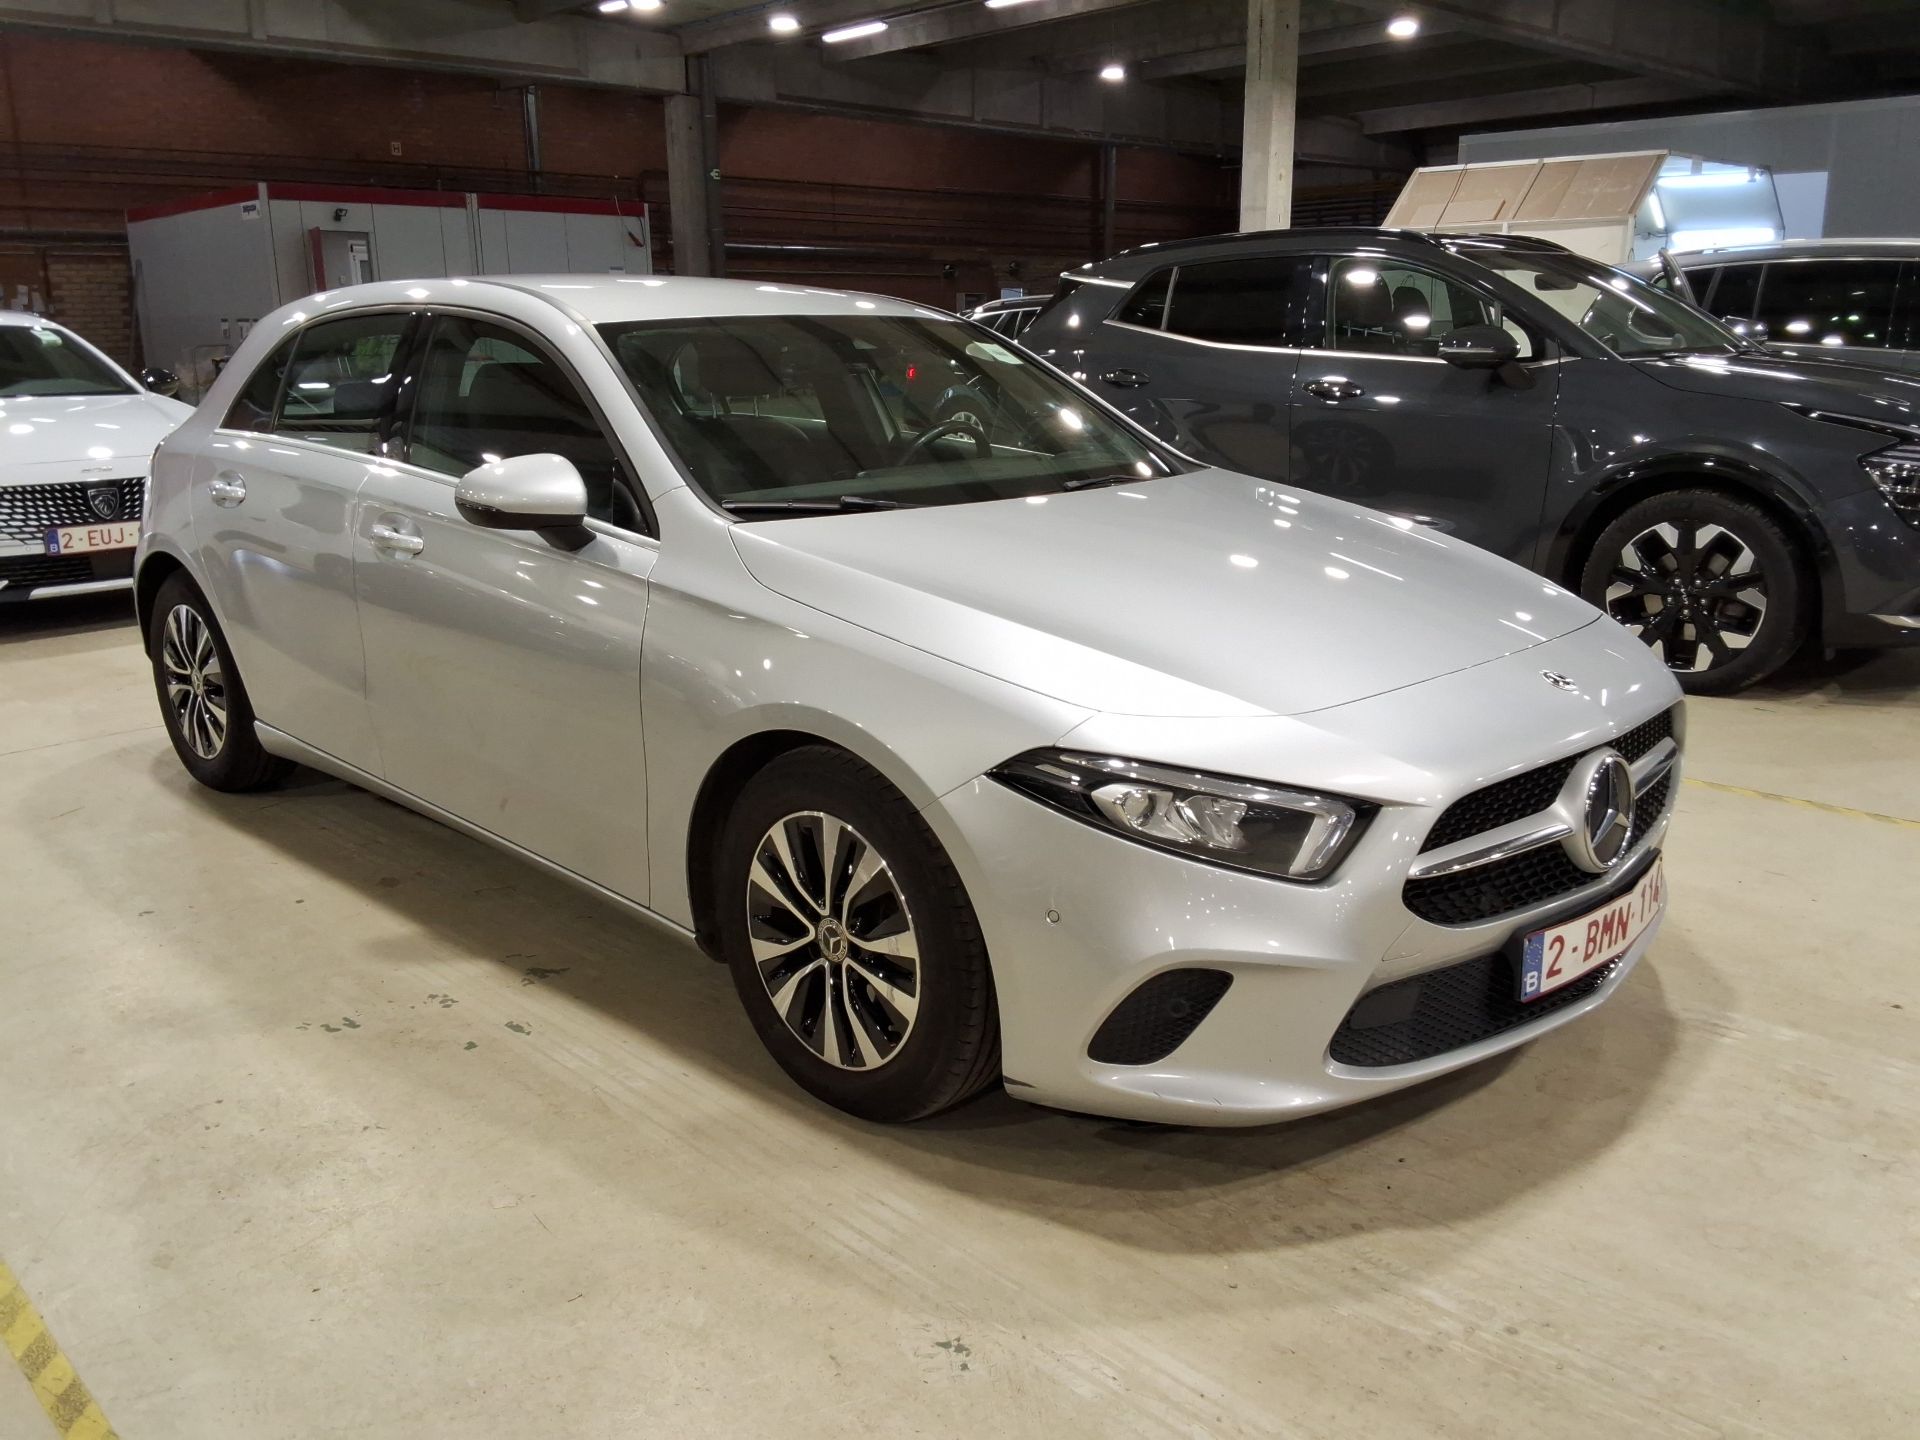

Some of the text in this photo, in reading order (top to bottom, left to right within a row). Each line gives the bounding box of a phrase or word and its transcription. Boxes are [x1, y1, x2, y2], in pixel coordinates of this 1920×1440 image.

[50, 544, 58, 553] B
[61, 528, 140, 550] 2-EUJ-
[1526, 971, 1538, 992] B
